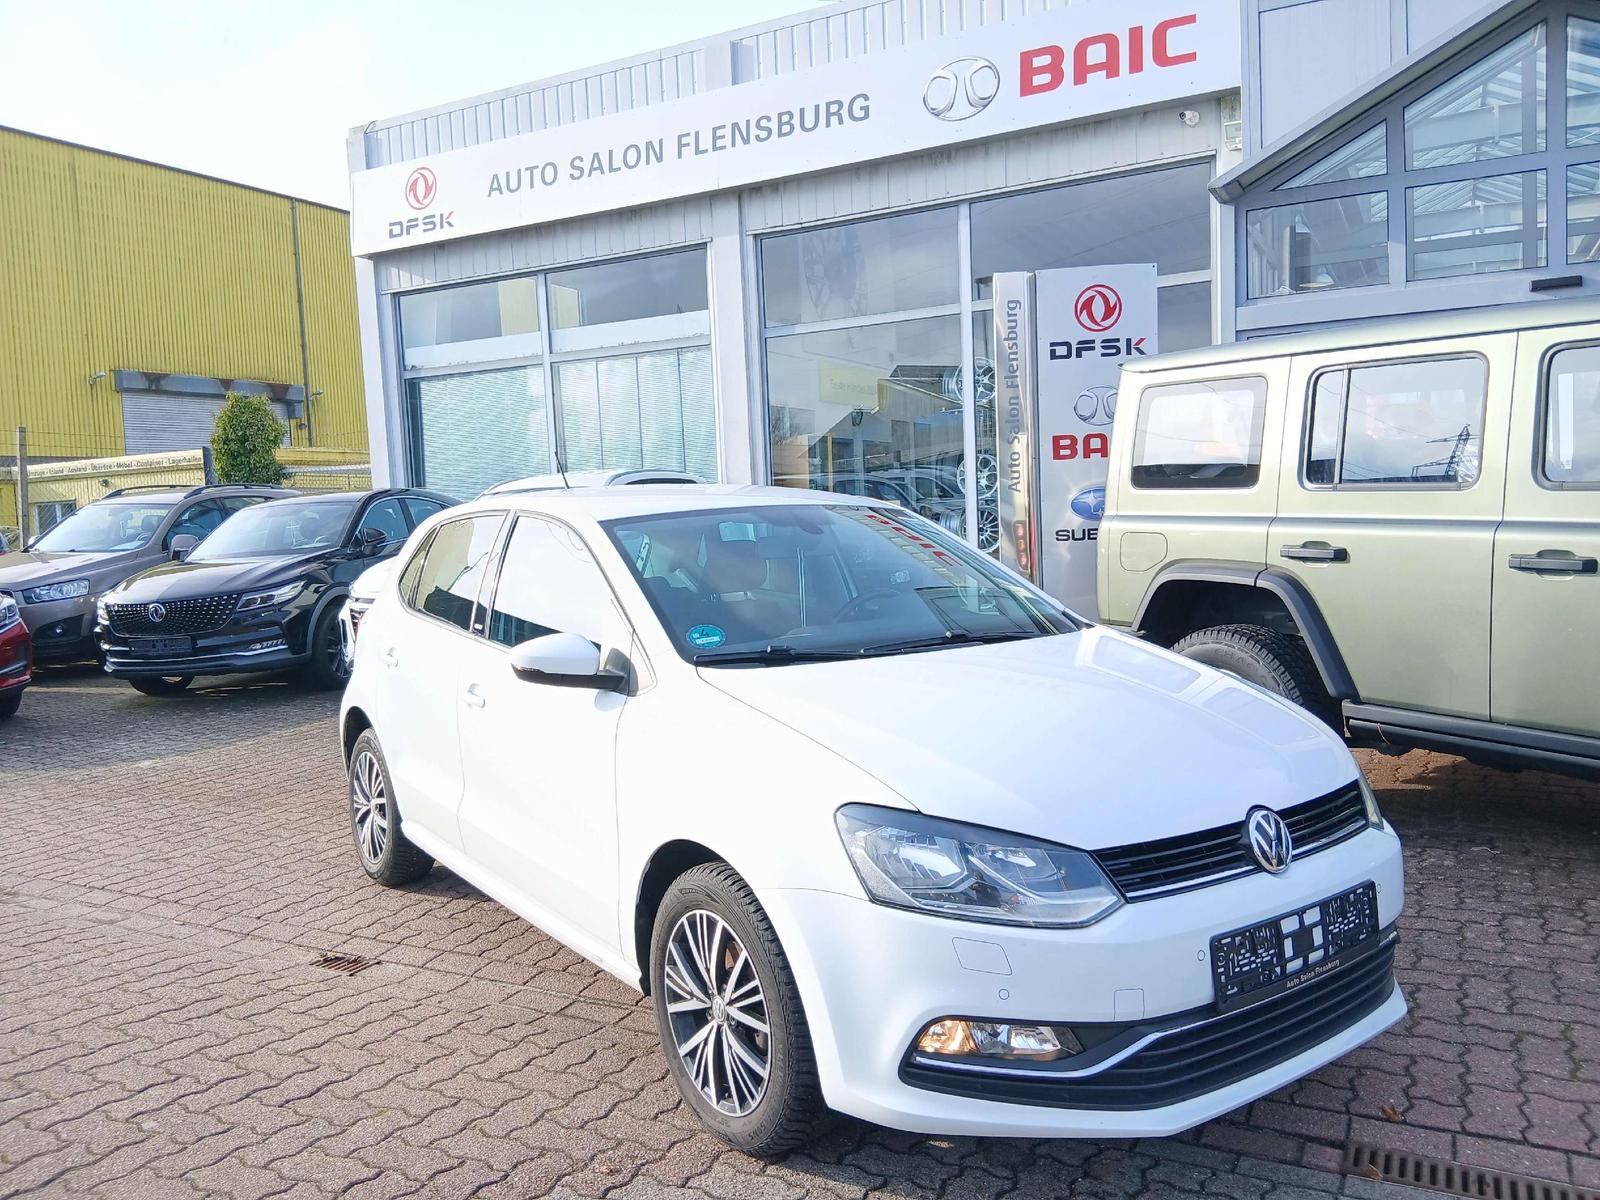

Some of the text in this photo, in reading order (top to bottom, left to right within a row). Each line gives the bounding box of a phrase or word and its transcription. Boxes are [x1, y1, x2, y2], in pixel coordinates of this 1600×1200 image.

[1019, 14, 1197, 97] BAIC
[487, 93, 871, 198] AUTO SALON FLENSBURG
[388, 210, 454, 239] DFSK
[1049, 337, 1147, 361] DFSK
[1003, 299, 1022, 493] Auto Salon Flensburg
[1052, 432, 1109, 461] BA
